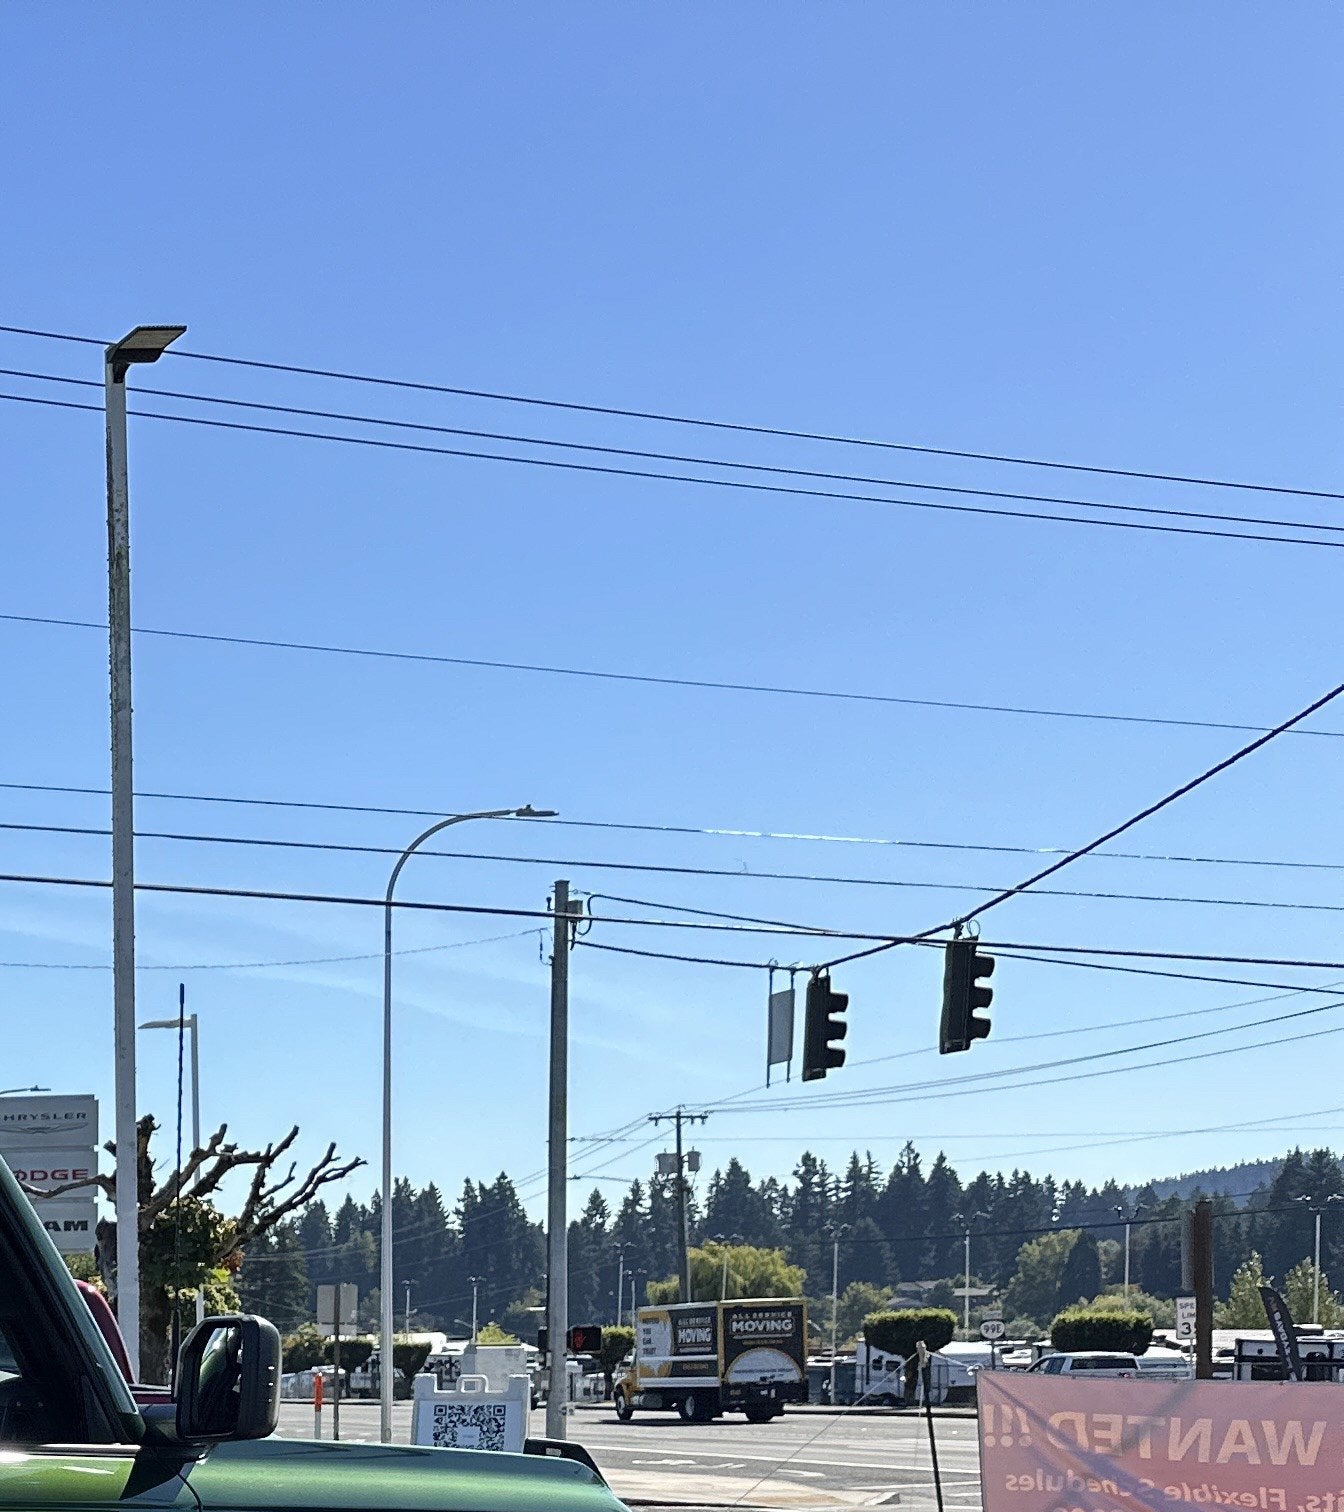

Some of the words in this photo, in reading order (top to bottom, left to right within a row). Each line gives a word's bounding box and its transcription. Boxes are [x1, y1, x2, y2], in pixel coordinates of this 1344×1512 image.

[12, 1168, 89, 1181] ODGE
[43, 1220, 88, 1232] AM
[732, 1319, 792, 1332] MOVING
[983, 1323, 1002, 1333] 99E
[1181, 1322, 1196, 1335] 3
[678, 1328, 711, 1343] MOVING
